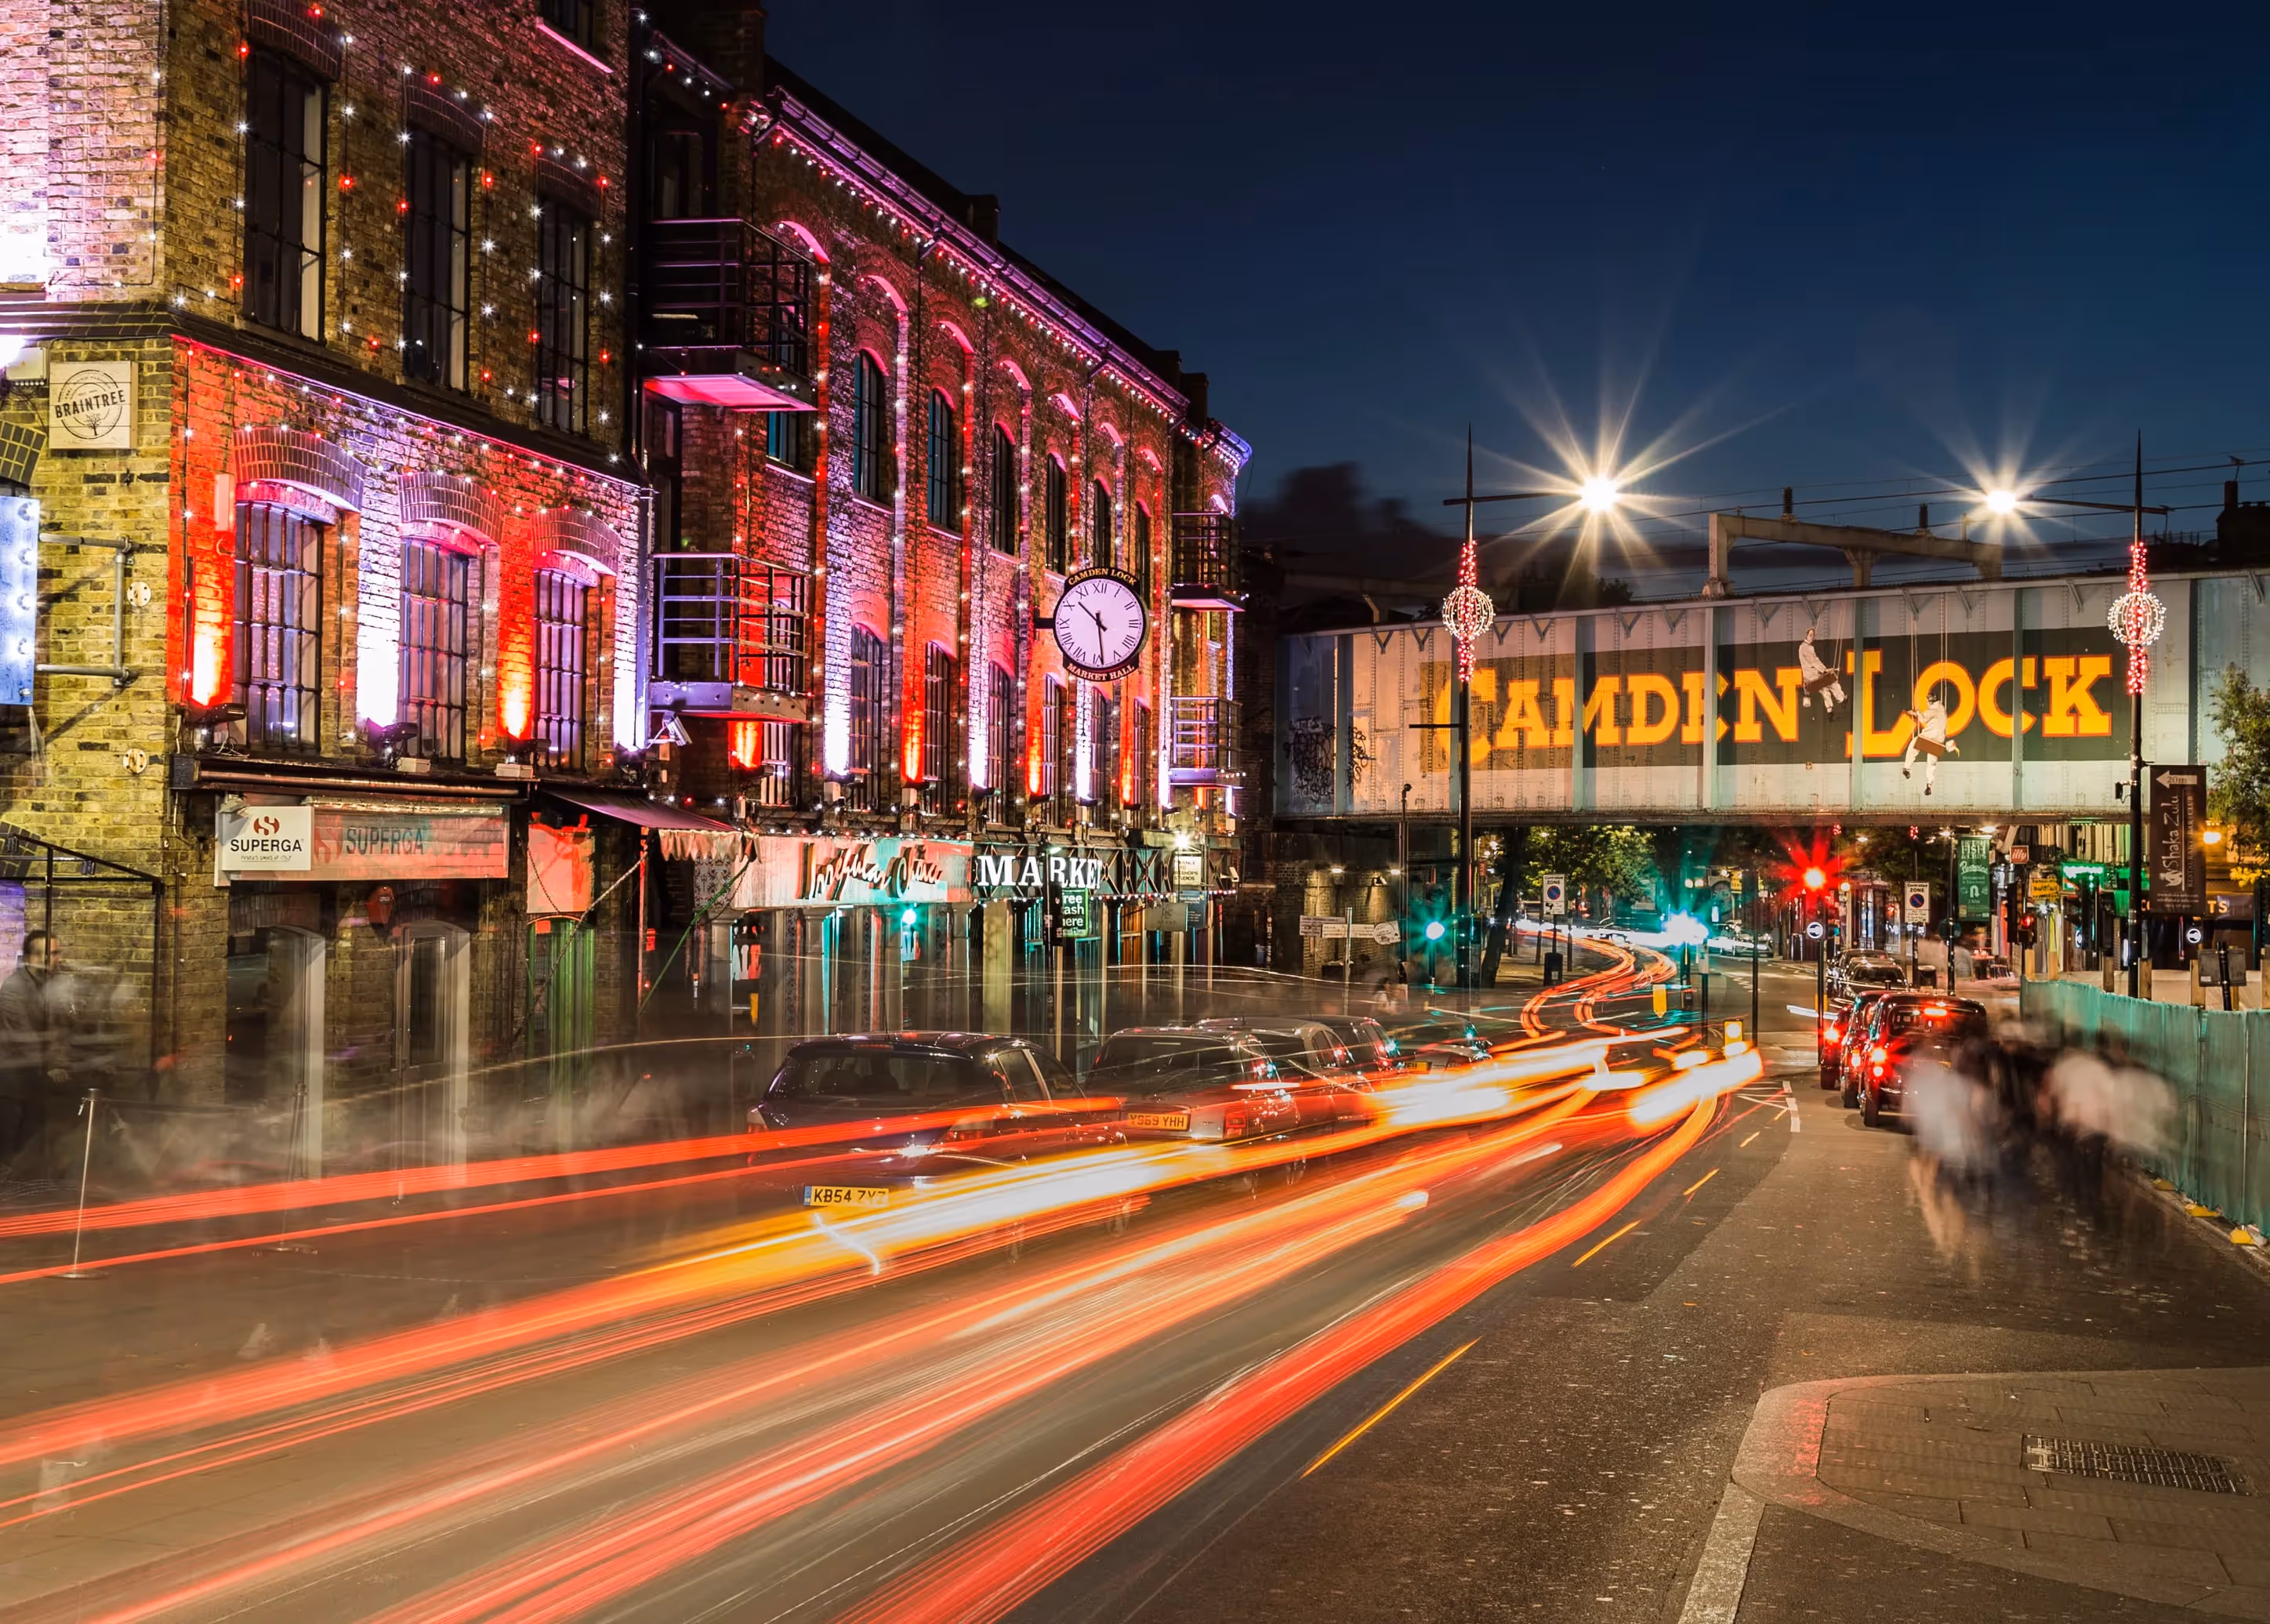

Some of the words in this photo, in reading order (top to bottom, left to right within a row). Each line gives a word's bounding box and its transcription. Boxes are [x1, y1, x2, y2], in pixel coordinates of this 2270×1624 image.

[55, 390, 125, 419] BRAINTREE
[1068, 568, 1108, 585] CAMDEN
[1111, 569, 1137, 585] LOCK
[1067, 663, 1108, 680] MARKET
[1109, 664, 1135, 680] HALL
[1436, 666, 1803, 764] CAMDEN
[1845, 648, 2112, 758] LOCK
[2167, 776, 2188, 785] 20m
[2161, 795, 2180, 826] Zulu
[230, 839, 303, 853] SUPERGA
[346, 827, 425, 855] SUPERGA
[1961, 846, 1986, 855] FISH
[2011, 849, 2027, 861] illy
[2162, 830, 2181, 873] Shaka
[1062, 893, 1083, 904] ree
[1062, 904, 1085, 915] ash
[1162, 1116, 1184, 1127] YHH
[814, 1188, 852, 1203] KB54
